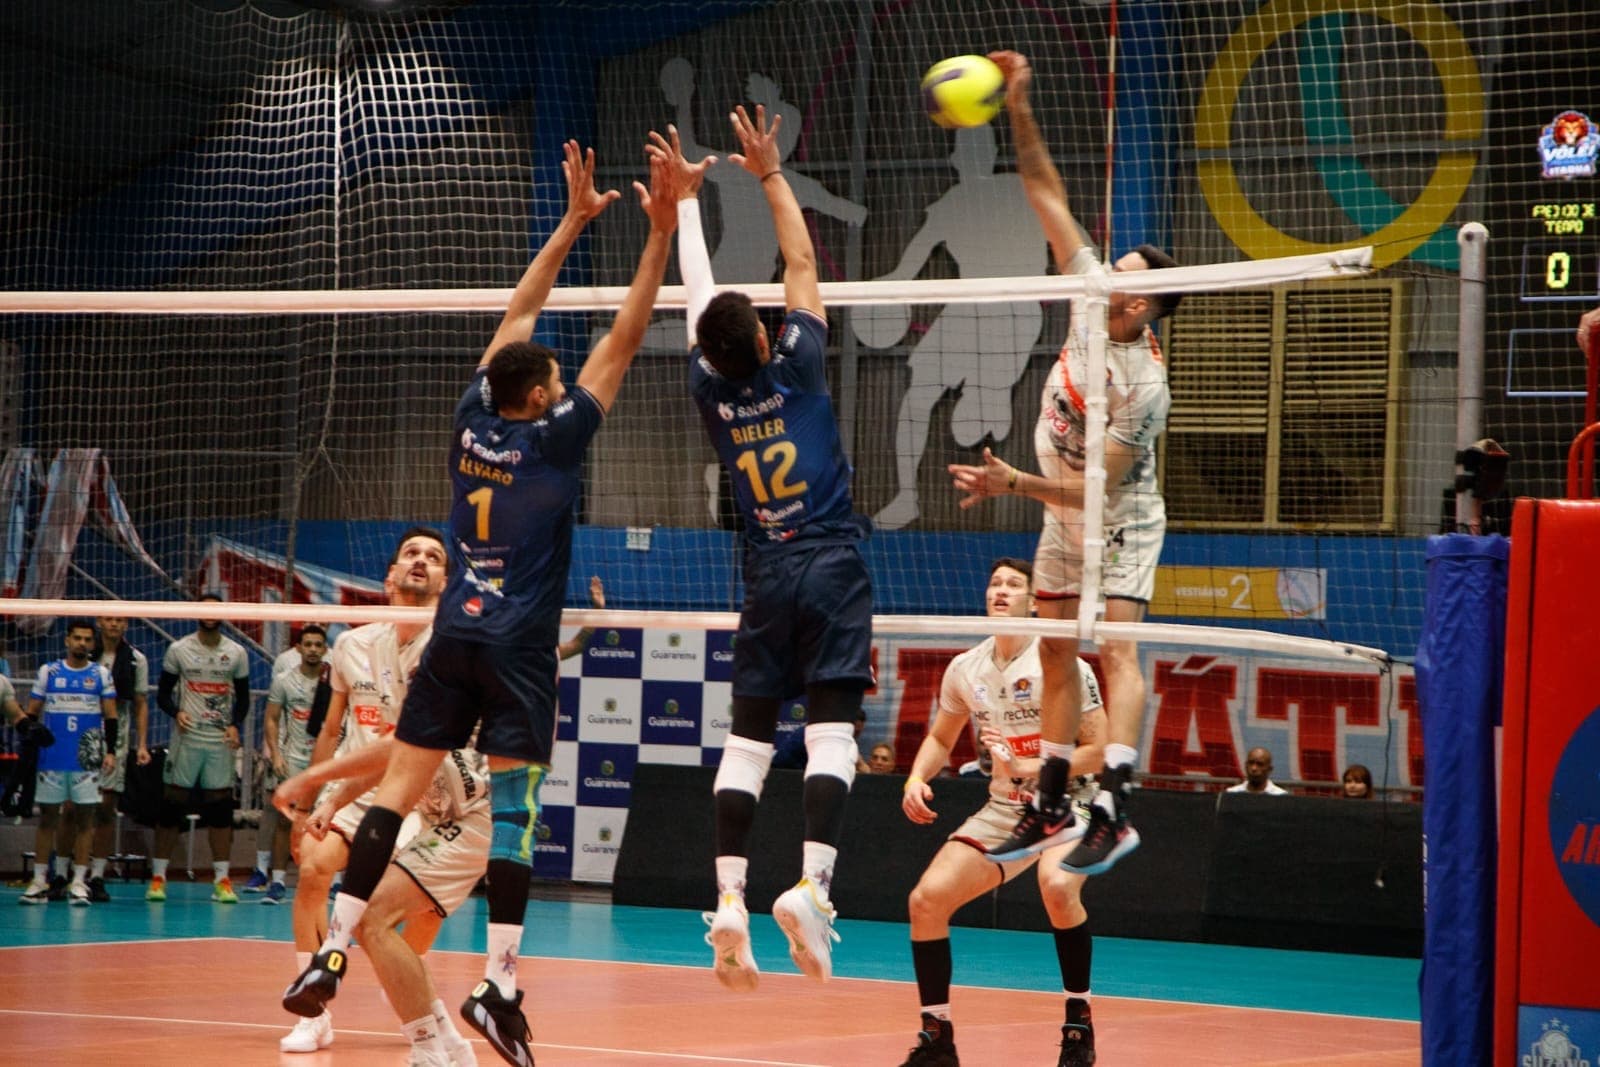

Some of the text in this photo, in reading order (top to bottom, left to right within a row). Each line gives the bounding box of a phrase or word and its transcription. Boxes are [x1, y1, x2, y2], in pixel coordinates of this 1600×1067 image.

[1547, 252, 1570, 288] 0
[730, 418, 785, 445] BIELER
[459, 453, 514, 486] ÁLVARO
[736, 441, 808, 503] 12
[467, 487, 494, 541] 1
[1230, 573, 1252, 609] 2
[589, 647, 636, 659] Guararema
[650, 650, 697, 661] Guararema
[67, 715, 78, 732] 6
[587, 714, 633, 726] Guararema
[648, 716, 695, 729] Guararema
[584, 777, 631, 790] Guararema
[433, 820, 462, 842] 23
